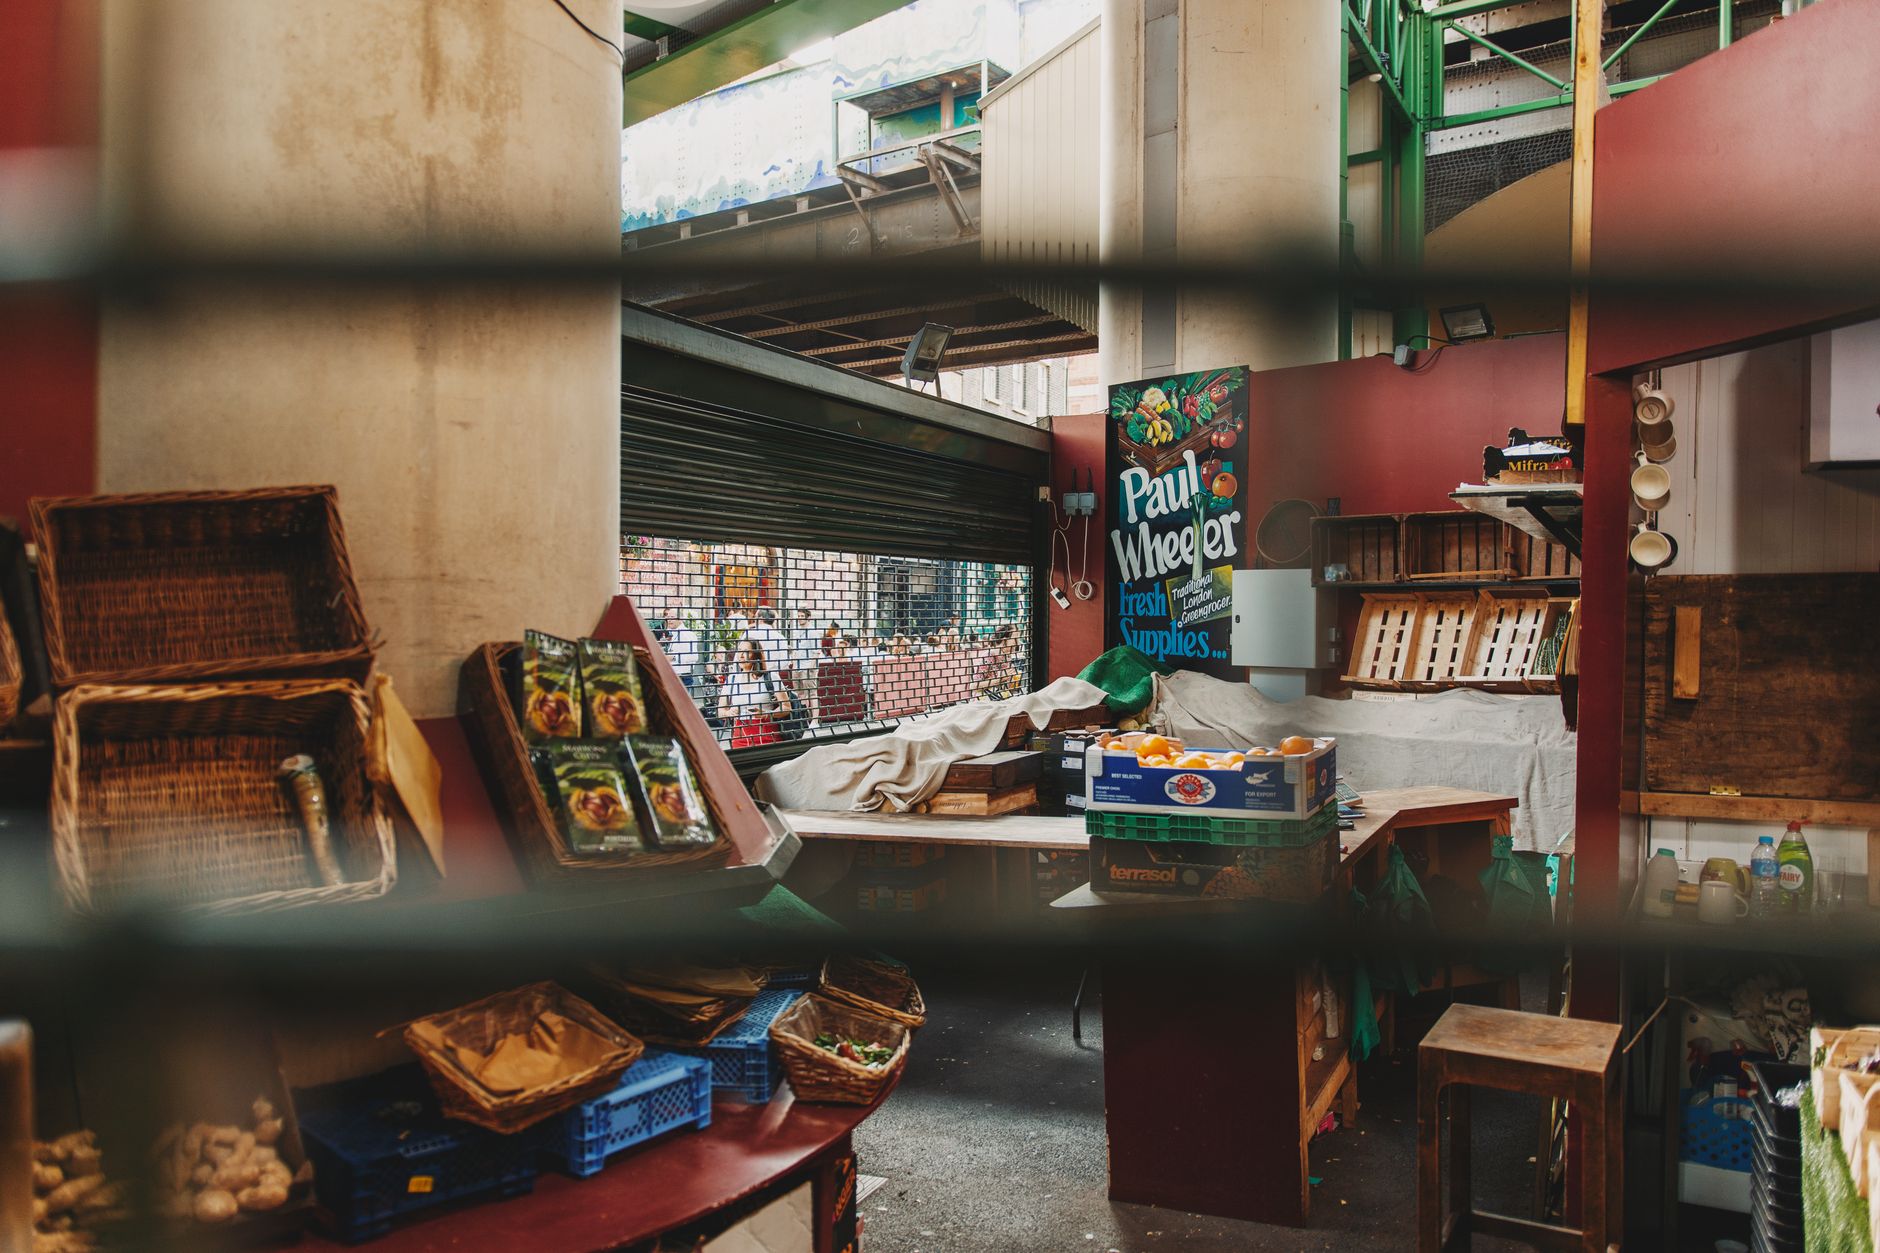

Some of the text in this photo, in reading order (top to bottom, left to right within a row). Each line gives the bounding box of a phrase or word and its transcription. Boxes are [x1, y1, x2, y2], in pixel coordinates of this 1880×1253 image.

[1508, 459, 1549, 472] Mifra
[1120, 449, 1200, 523] Paul
[1110, 510, 1241, 584] Wheeler
[1119, 582, 1167, 617] Fresh
[1171, 570, 1213, 601] Traditional
[1183, 588, 1213, 610] London
[1110, 864, 1177, 882] terrasol
